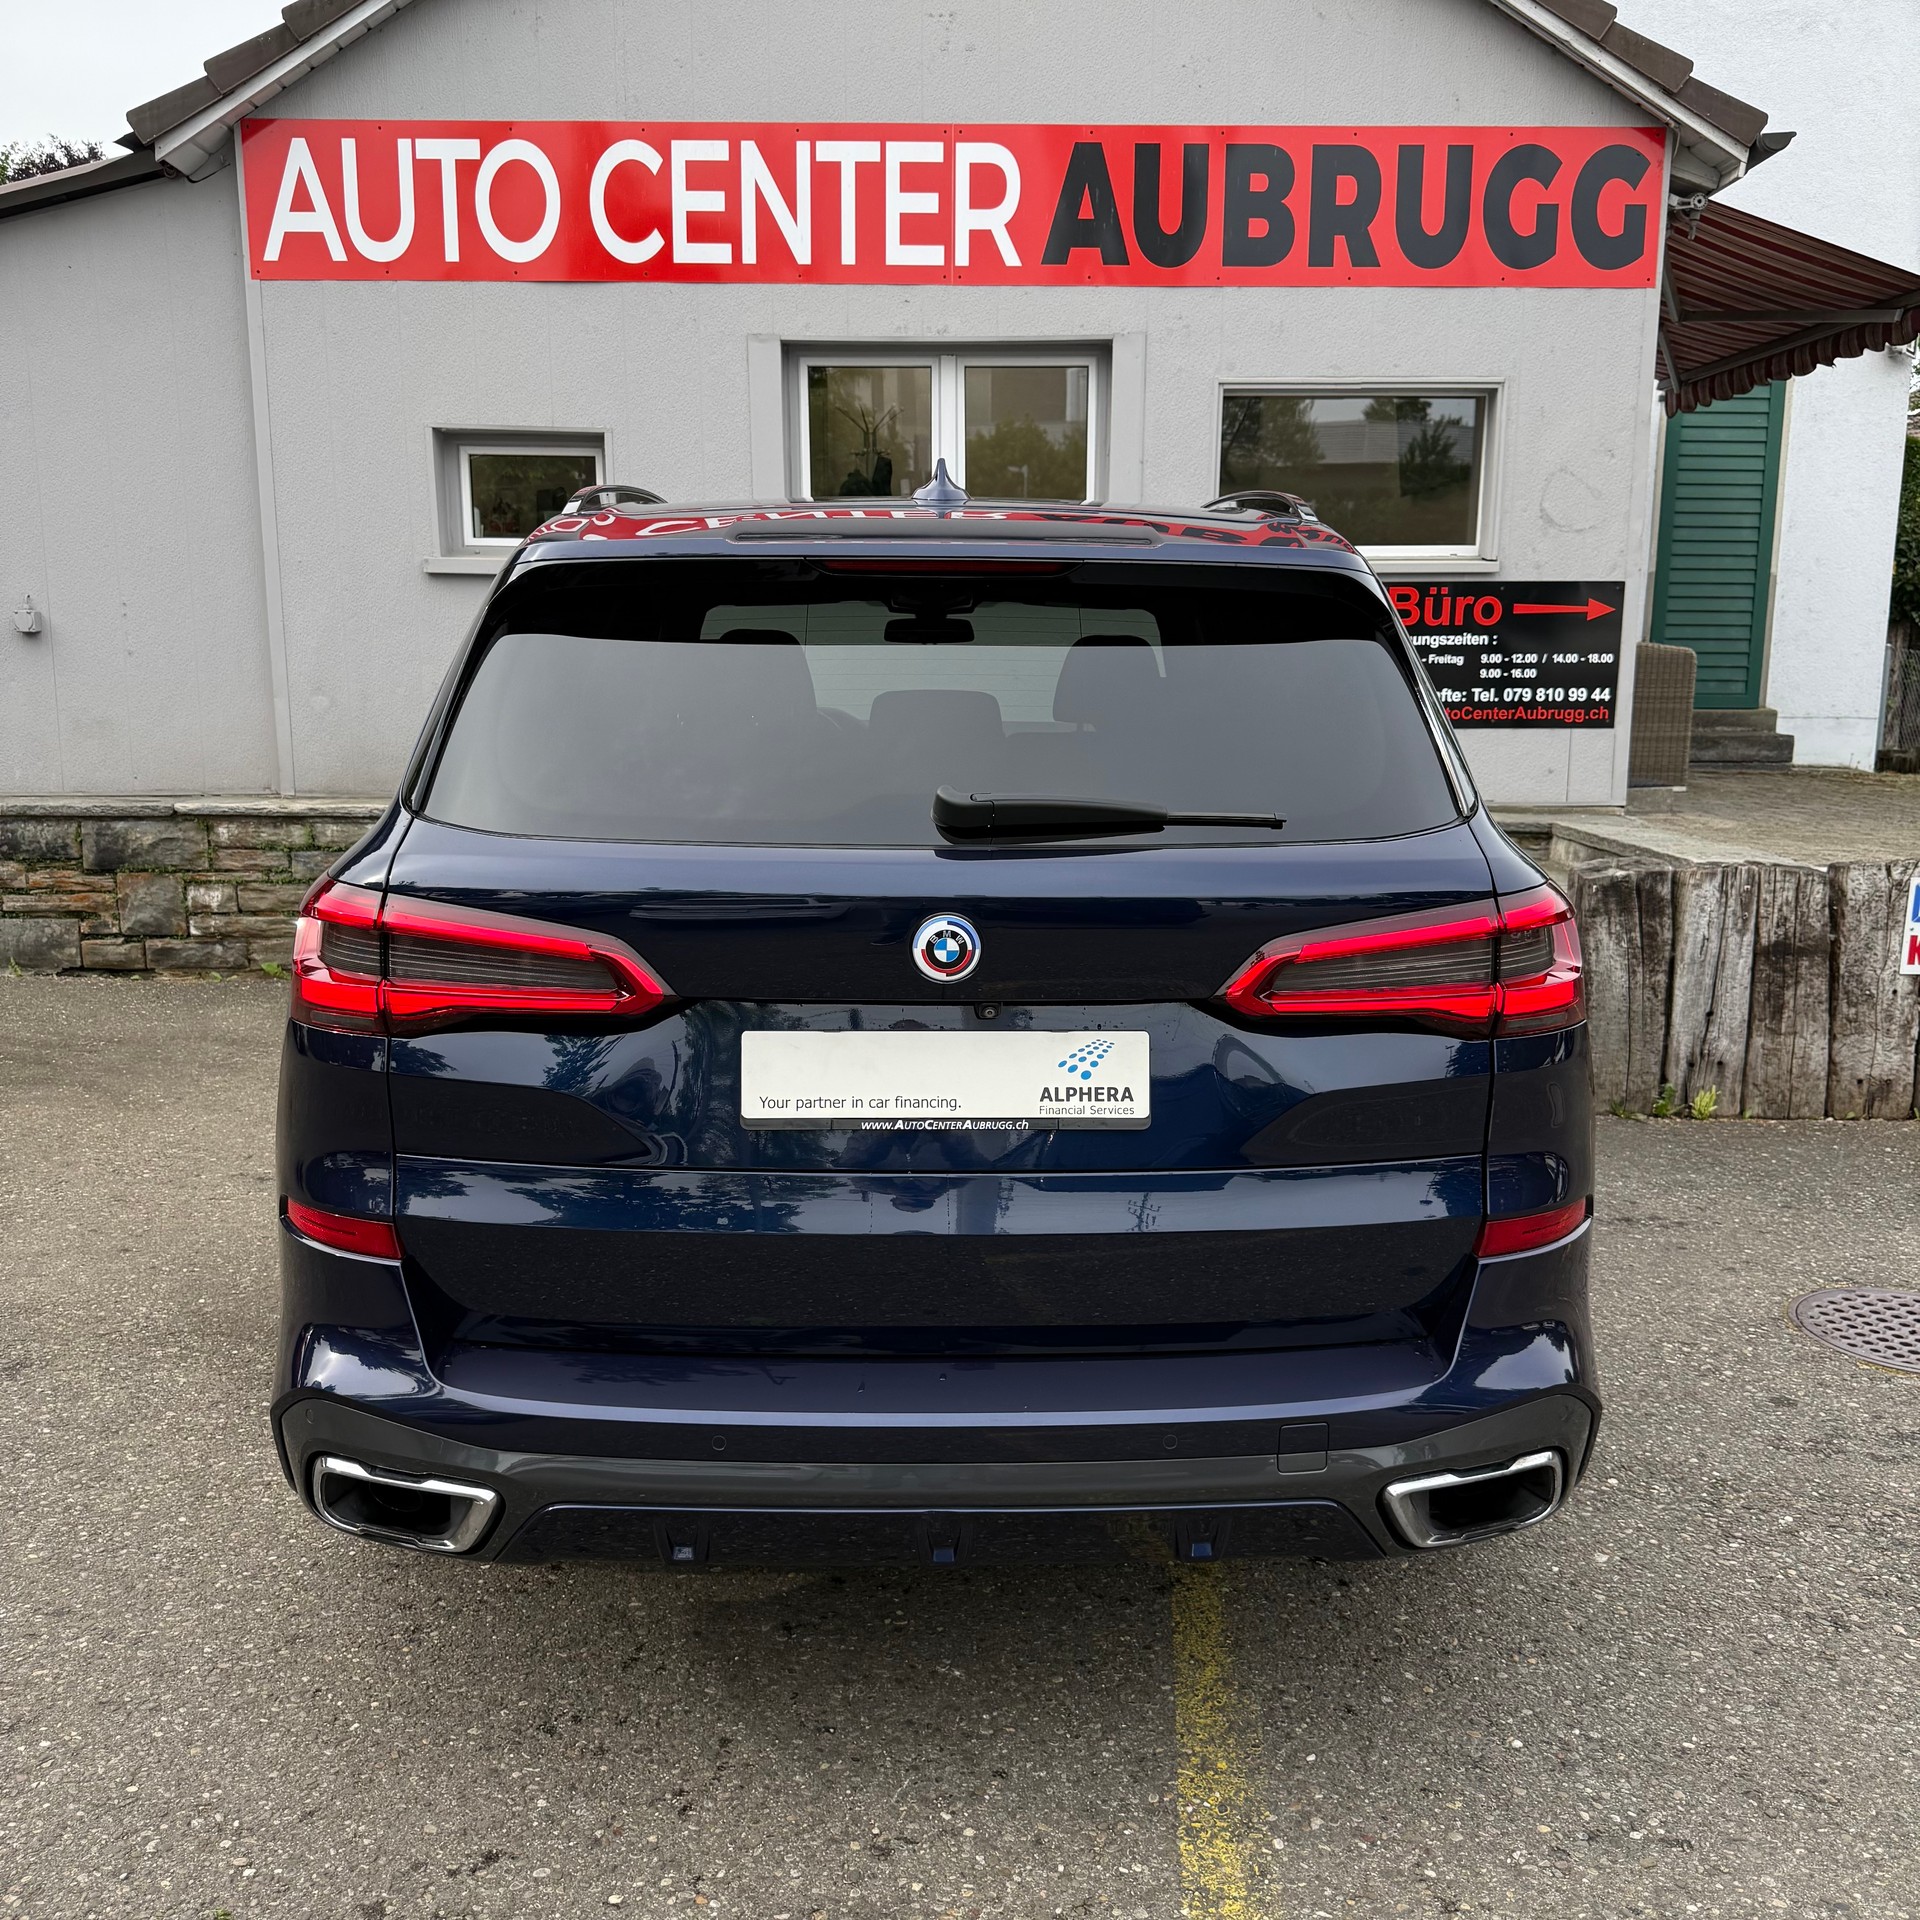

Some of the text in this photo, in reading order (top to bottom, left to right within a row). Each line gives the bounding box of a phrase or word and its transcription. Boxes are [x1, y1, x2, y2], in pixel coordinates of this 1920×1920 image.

[263, 137, 1652, 271] AUTO CENTER AUBRUGG
[1388, 586, 1503, 626] Büro
[1428, 654, 1465, 666] Freitag
[1480, 653, 1503, 664] 9.00
[1511, 653, 1539, 664] 12.00
[1551, 653, 1580, 664] 14.00
[1587, 653, 1615, 664] 18.00
[1479, 668, 1502, 679] 9.00
[1510, 668, 1538, 679] 16.00
[1471, 687, 1500, 702] Tel.
[1503, 687, 1533, 702] 079
[1535, 687, 1565, 702] 810
[1568, 687, 1588, 702] 99
[1590, 687, 1612, 702] 44
[929, 930, 965, 945] BMW
[1039, 1086, 1135, 1103] ALPHERA
[759, 1095, 962, 1112] Your partner in car financing.
[1039, 1105, 1135, 1115] Financial Services
